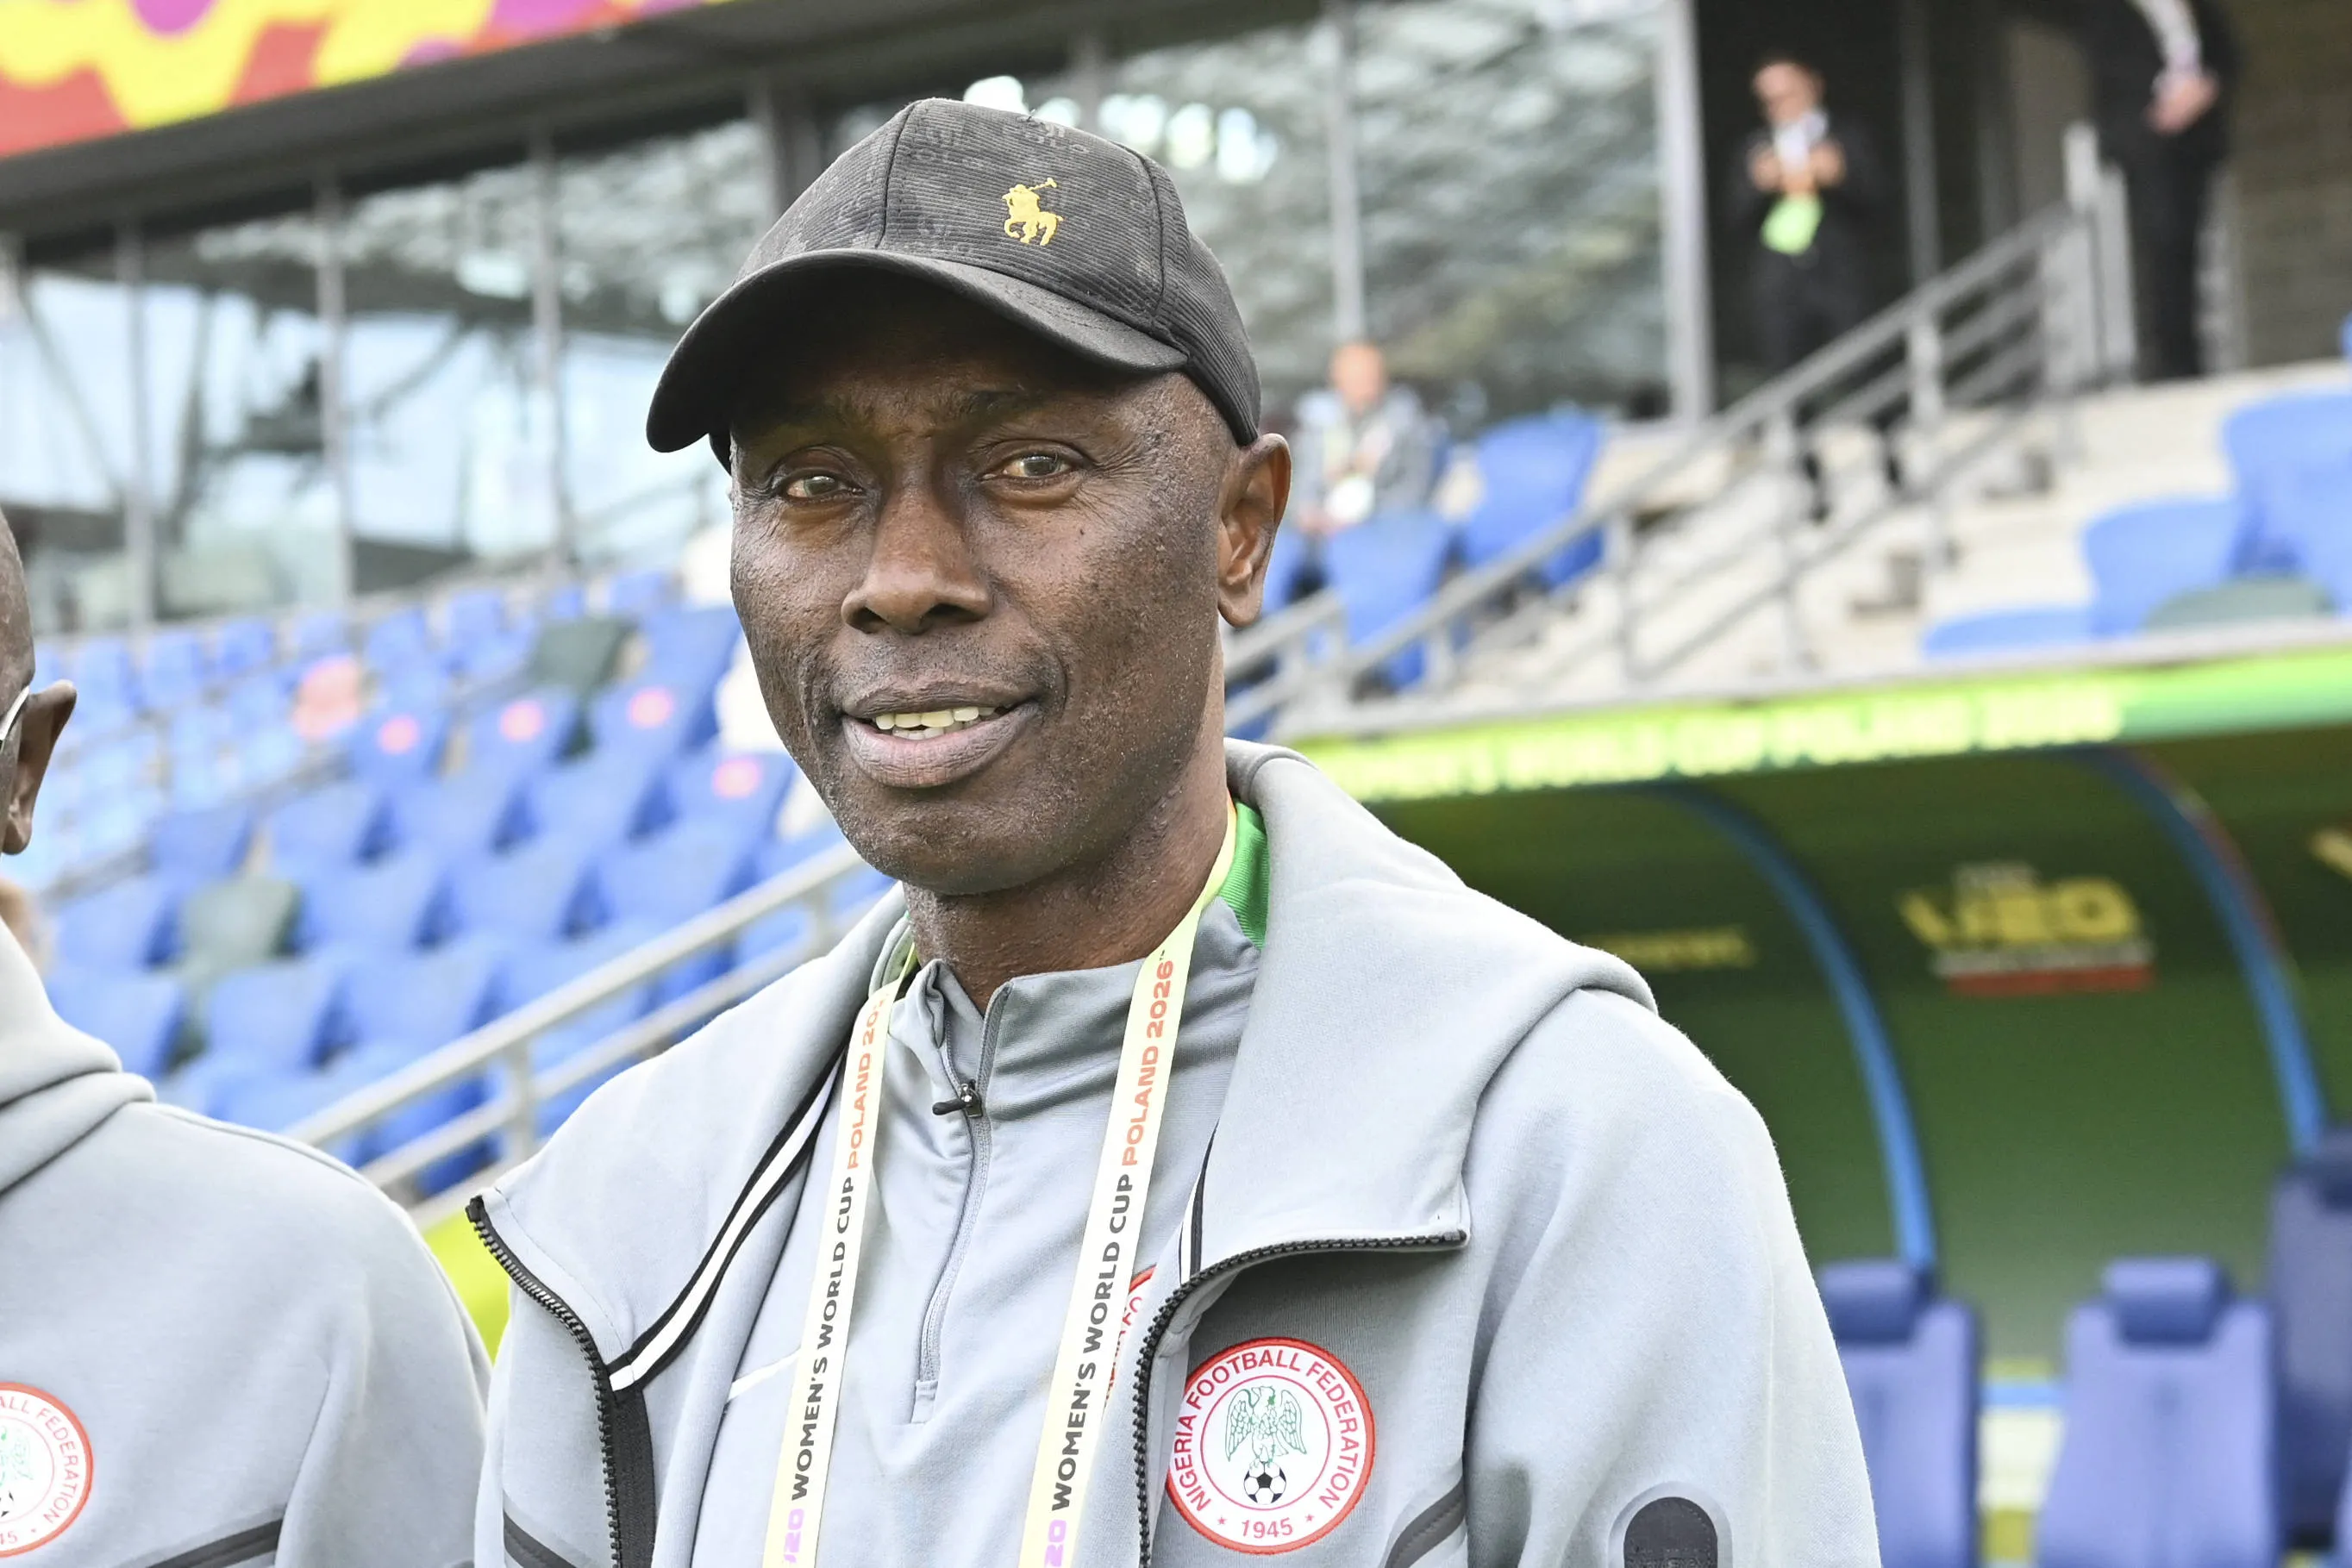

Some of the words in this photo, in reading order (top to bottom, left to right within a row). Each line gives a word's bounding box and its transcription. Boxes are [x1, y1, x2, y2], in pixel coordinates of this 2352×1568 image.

[791, 1357, 828, 1501] WOMEN'S
[817, 1241, 846, 1350] WORLD
[837, 1176, 854, 1234] CUP
[848, 1053, 872, 1170] POLAND
[1051, 1362, 1096, 1511] WOMEN'S
[1083, 1241, 1120, 1353] WORLD
[1110, 1174, 1133, 1234] CUP
[1122, 1046, 1160, 1166] POLAND
[1185, 1349, 1301, 1410] FOOTBALL
[1305, 1360, 1360, 1509] FEDERATION
[36, 1407, 79, 1524] FEDERATION
[1173, 1413, 1211, 1512] NIGERIA
[1241, 1517, 1293, 1539] 1945
